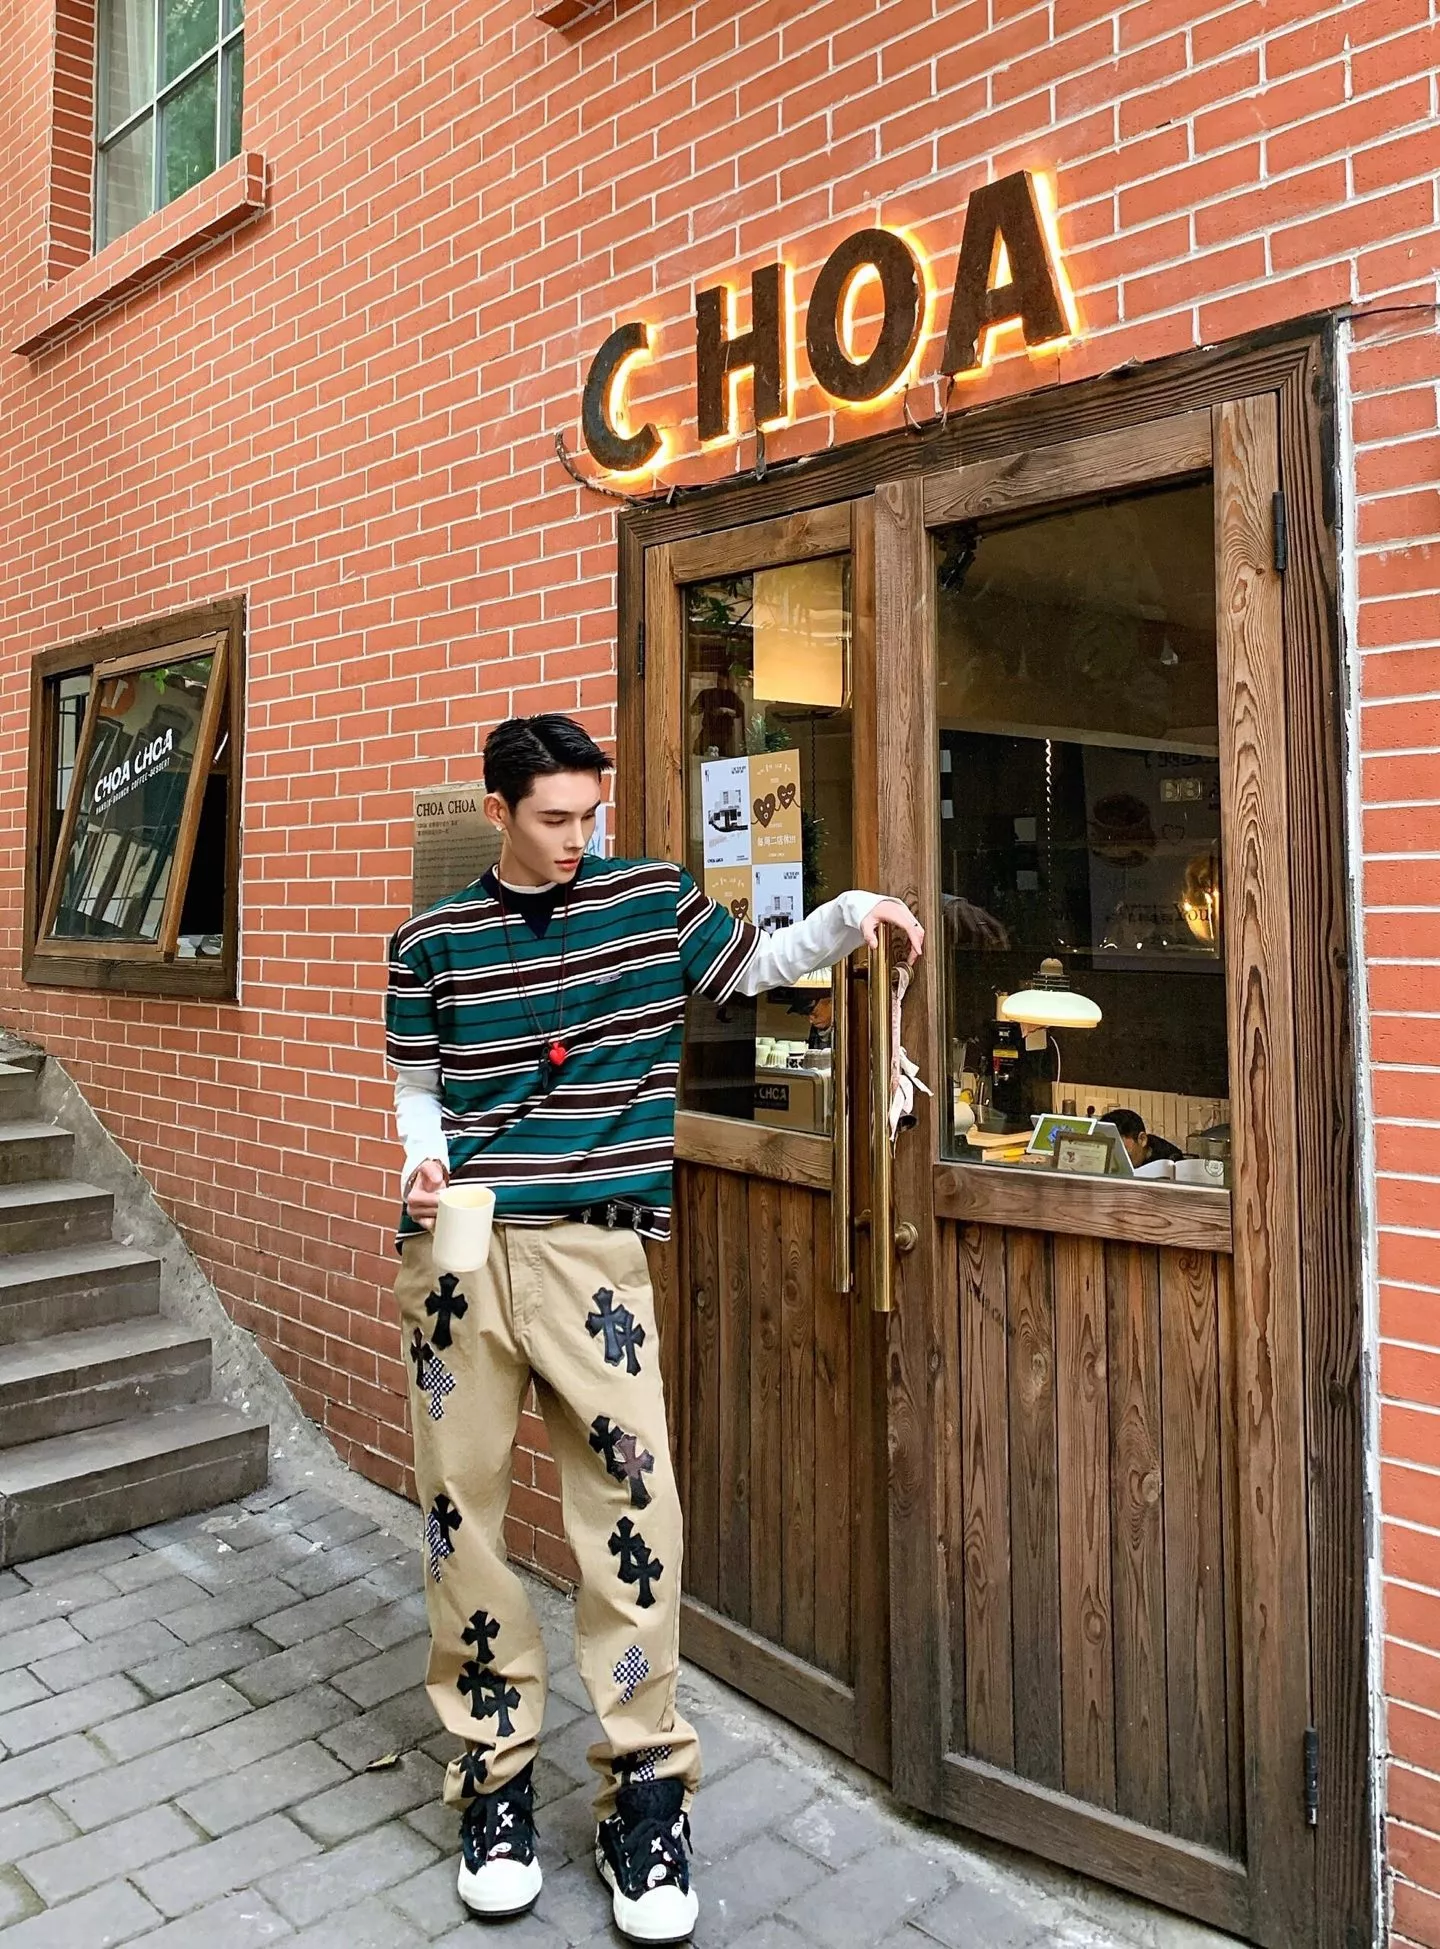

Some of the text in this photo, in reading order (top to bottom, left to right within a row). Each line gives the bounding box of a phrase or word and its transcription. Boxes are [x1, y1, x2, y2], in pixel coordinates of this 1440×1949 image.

[582, 169, 1073, 472] CHOA
[94, 728, 173, 803] CHOA CHOA
[416, 799, 477, 817] CHOA CHOA
